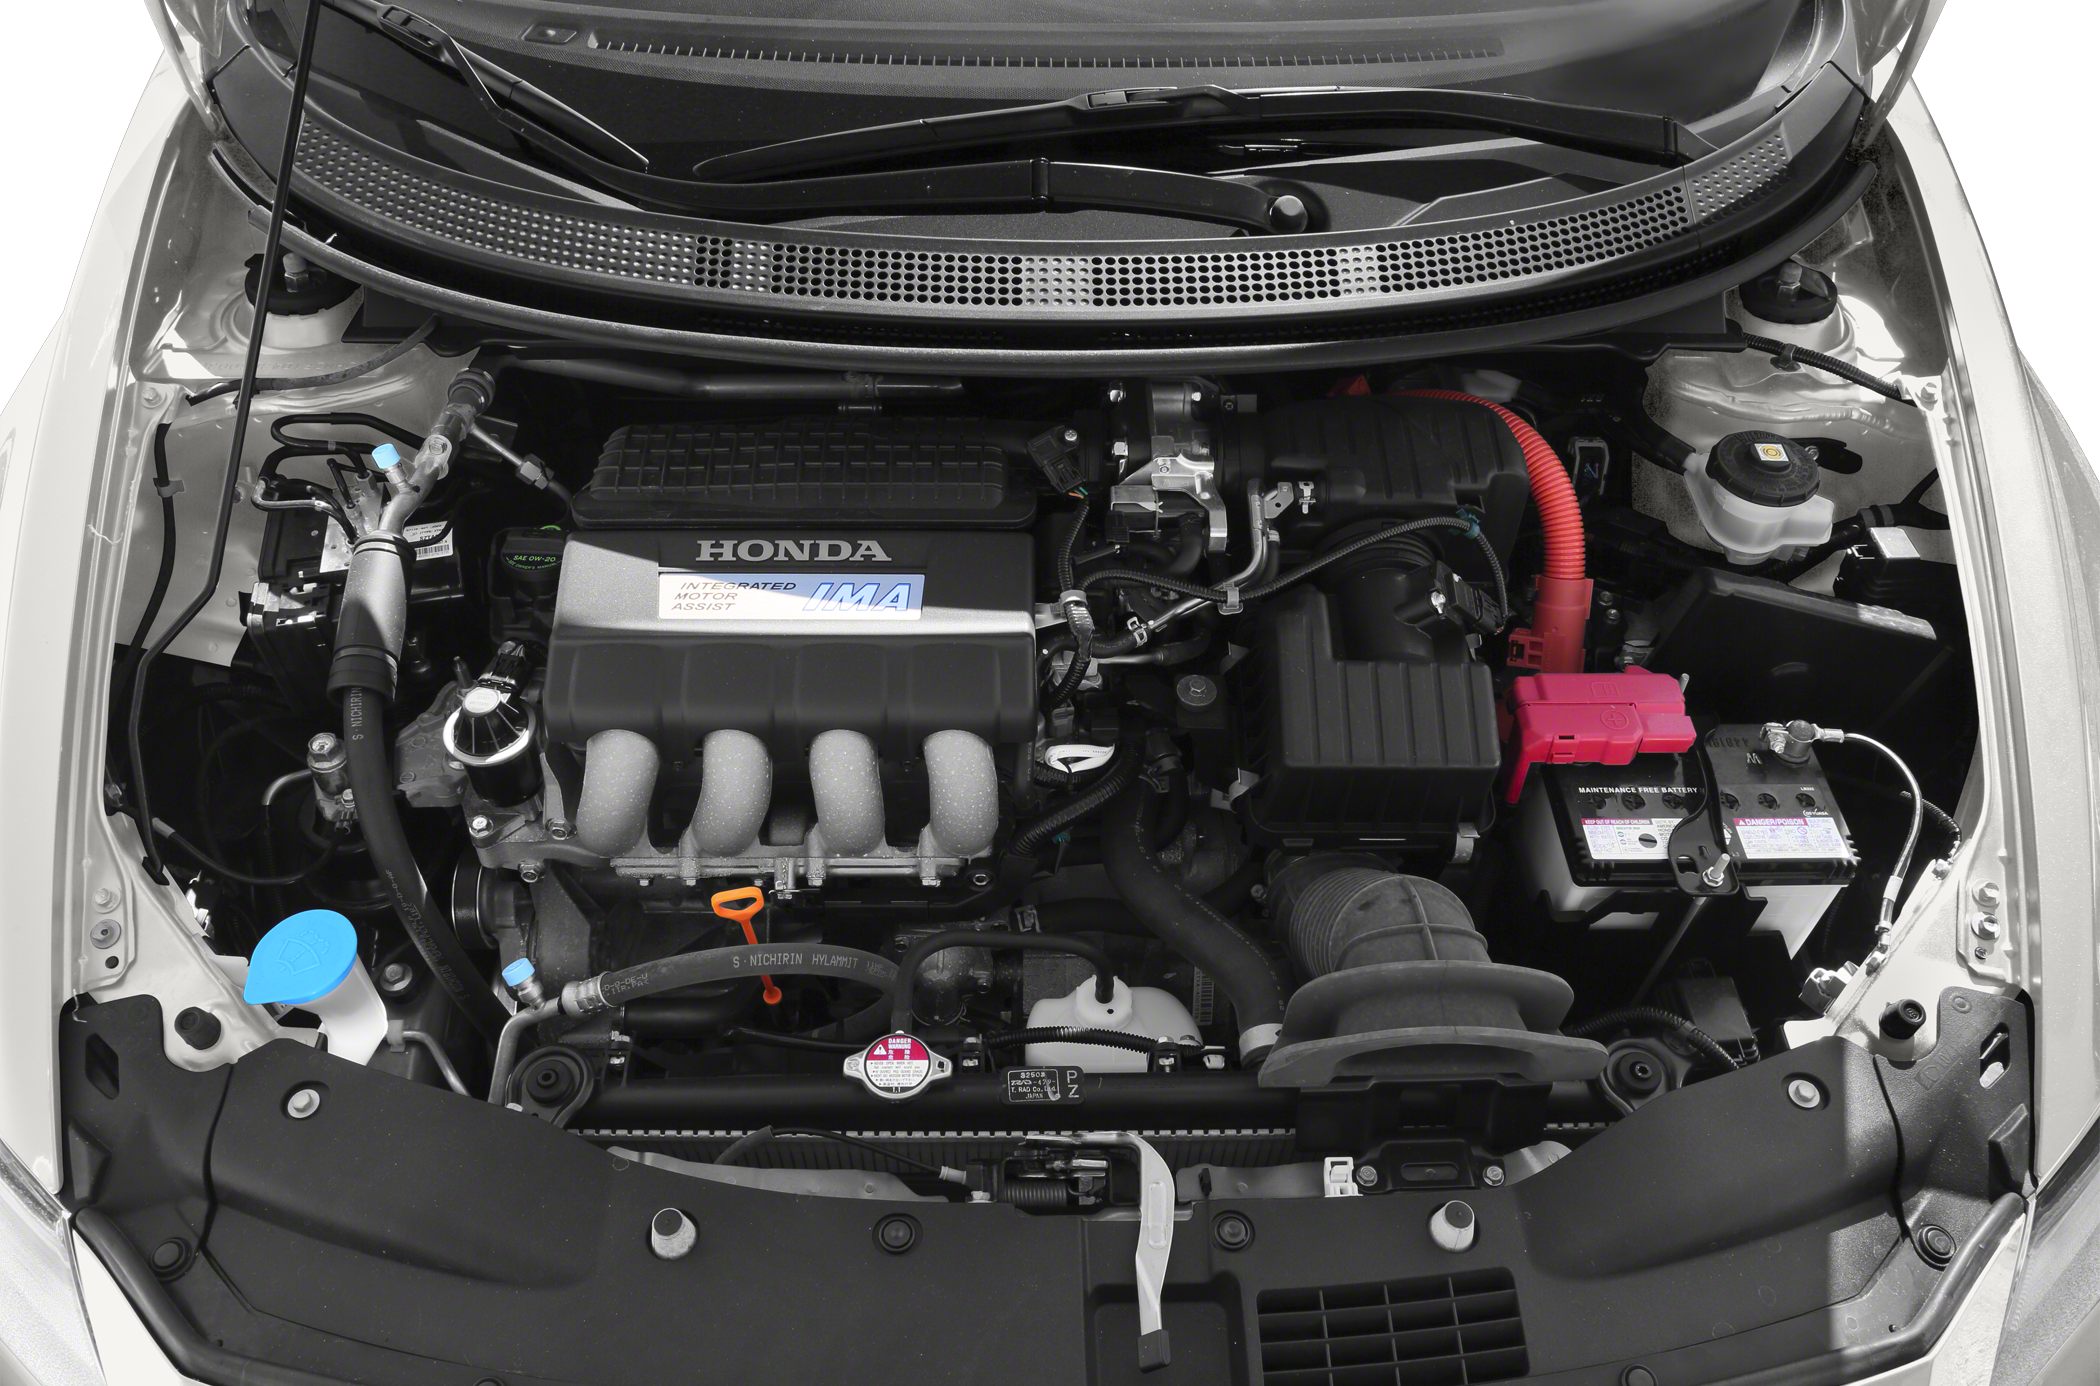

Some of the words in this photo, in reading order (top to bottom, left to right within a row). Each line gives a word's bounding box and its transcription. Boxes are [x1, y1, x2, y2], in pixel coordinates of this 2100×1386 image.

[696, 540, 892, 562] HONDA
[680, 582, 797, 591] INTEGRATED
[674, 592, 738, 600] MOTOR
[802, 582, 912, 612] IMA
[671, 602, 736, 611] ASSIST
[811, 953, 859, 969] HYLAMMIT
[1066, 1070, 1078, 1084] P
[1067, 1084, 1080, 1098] Z
